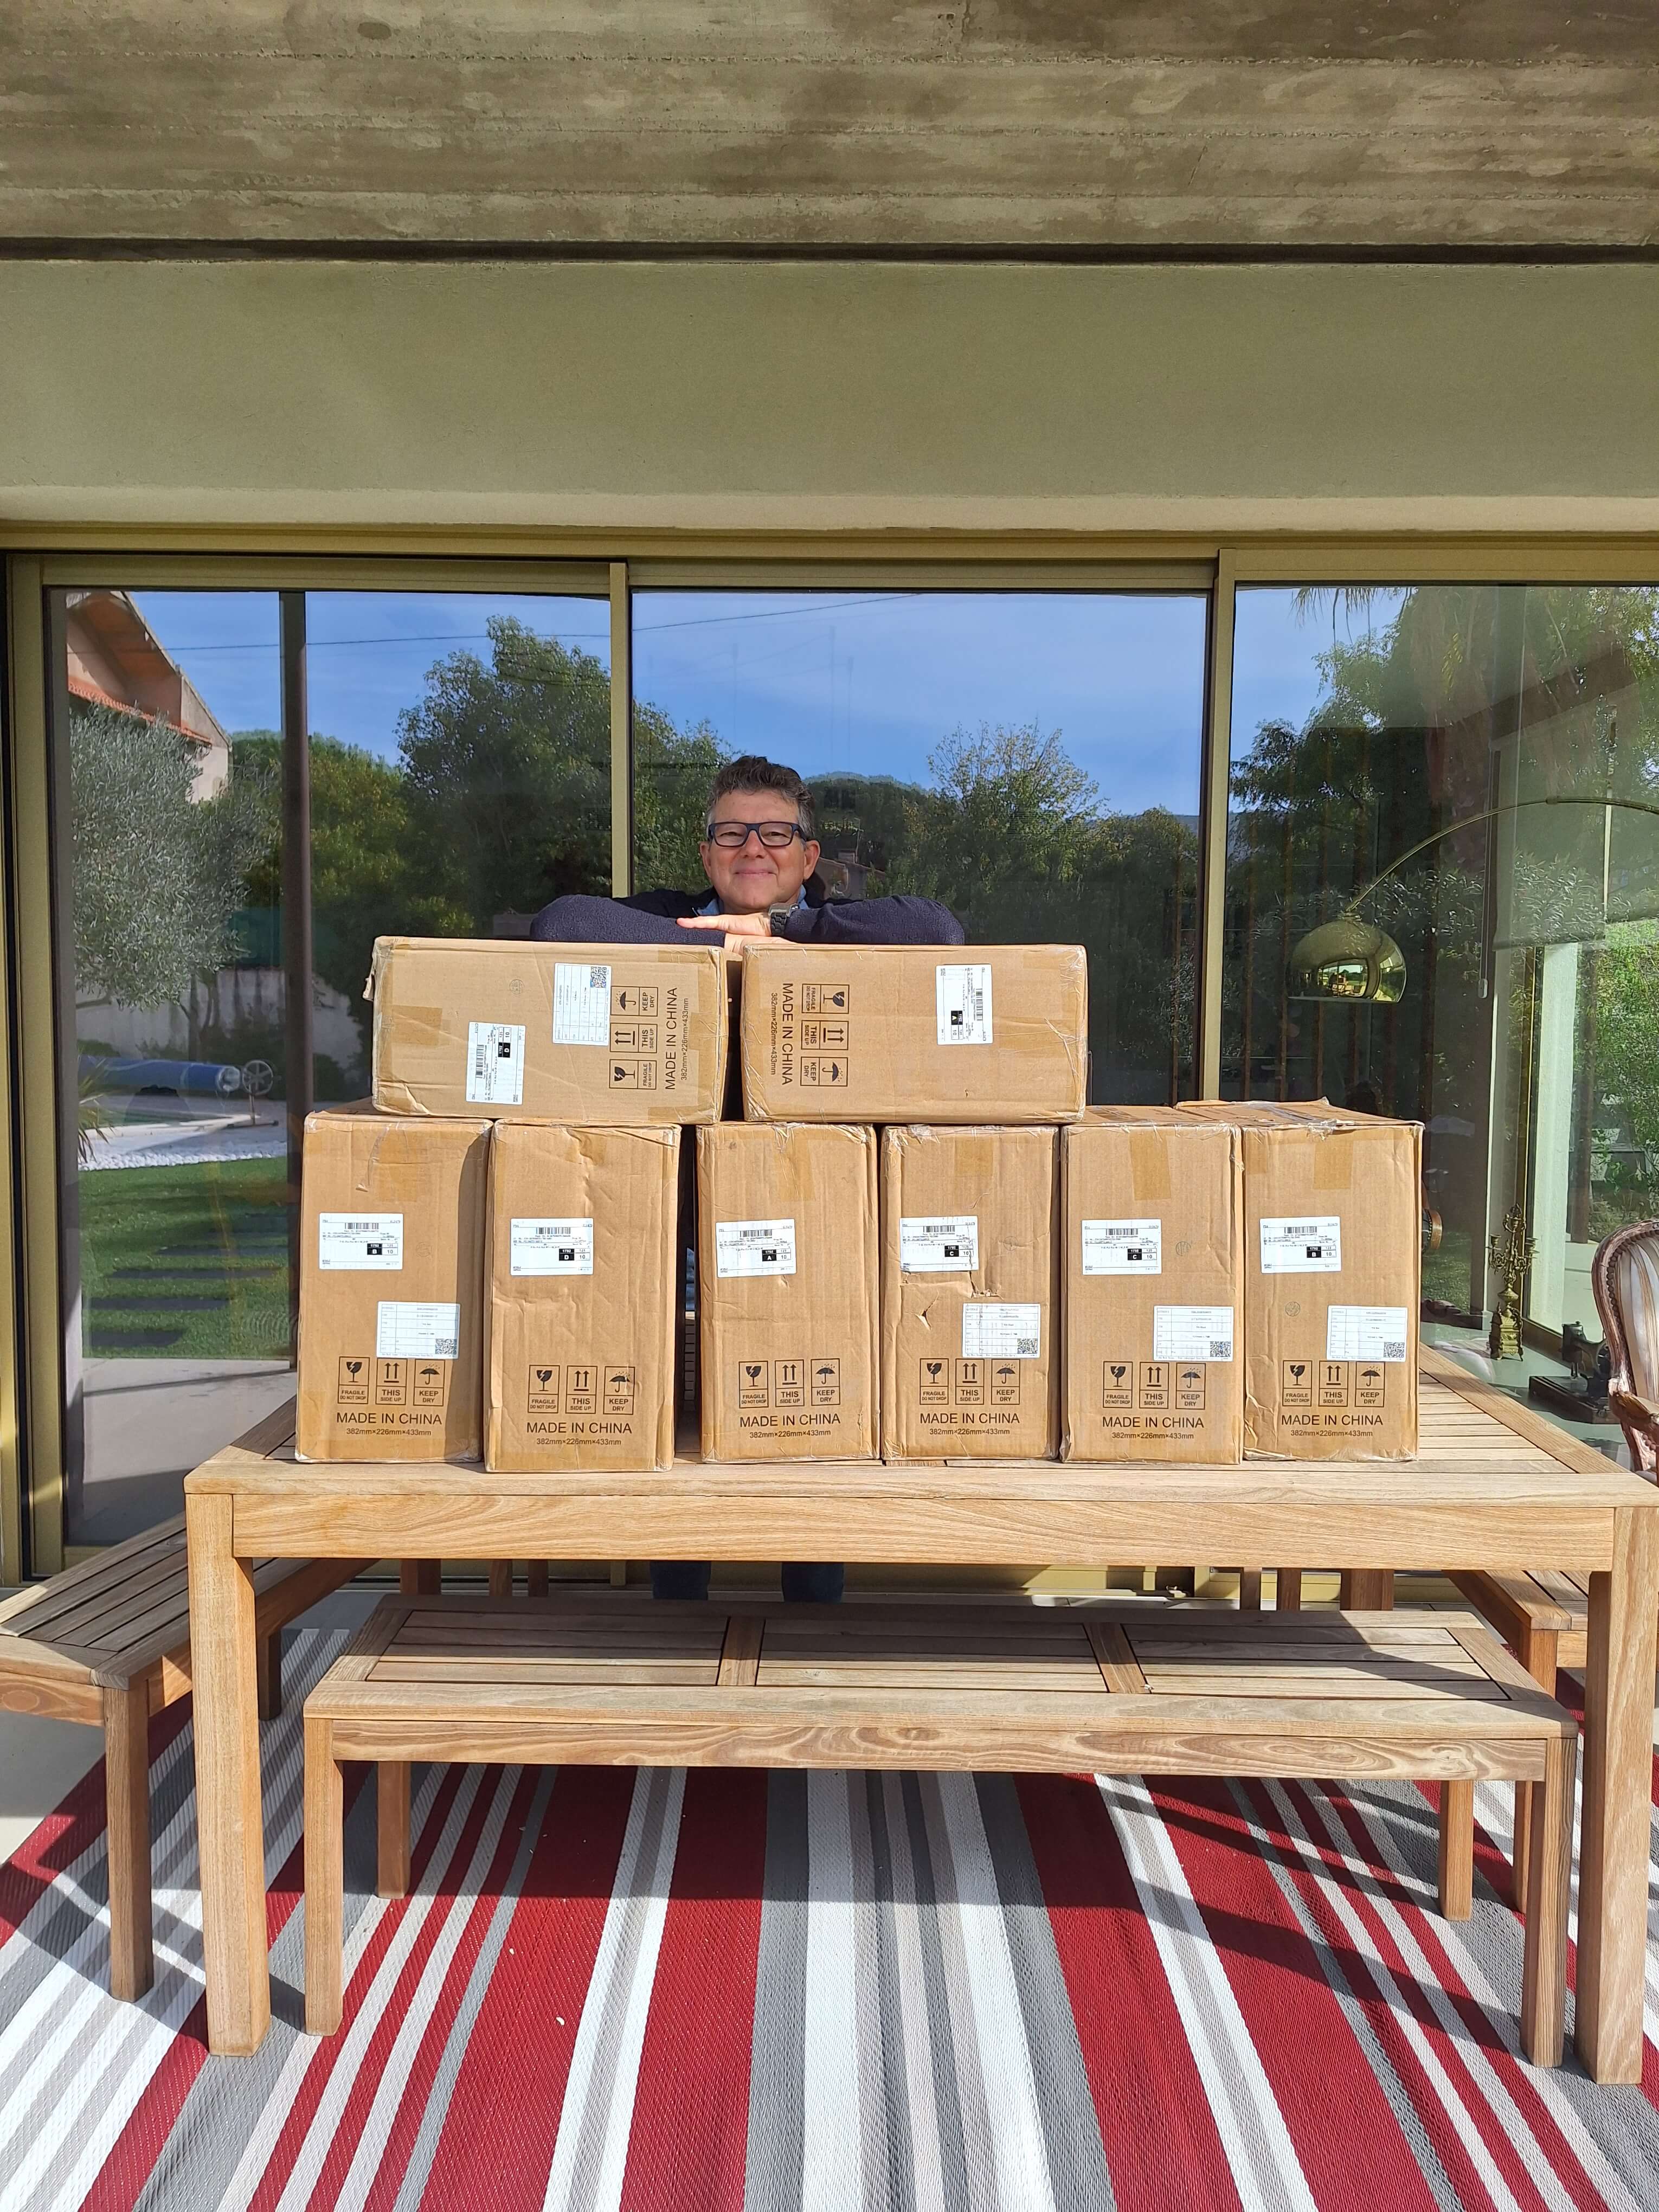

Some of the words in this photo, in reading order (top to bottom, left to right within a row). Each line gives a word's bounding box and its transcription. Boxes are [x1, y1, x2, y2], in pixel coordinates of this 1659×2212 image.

[782, 983, 793, 1021] MADE
[666, 988, 677, 1029] CHINA
[782, 1027, 793, 1038] IN
[666, 1035, 676, 1046] IN
[782, 1044, 793, 1085] CHINA
[665, 1052, 676, 1089] MADE
[337, 1413, 377, 1423] MADE
[382, 1413, 394, 1423] IN
[400, 1414, 442, 1424] CHINA
[740, 1416, 778, 1427] MADE
[783, 1415, 795, 1425] IN
[800, 1413, 840, 1425] CHINA
[920, 1413, 957, 1423] MADE
[962, 1413, 974, 1423] IN
[979, 1413, 1020, 1423] CHINA
[1103, 1417, 1140, 1427] MADE
[1146, 1417, 1157, 1427] IN
[1162, 1417, 1204, 1428] CHINA
[1282, 1415, 1320, 1425] MADE
[1325, 1415, 1336, 1425] IN
[1341, 1415, 1383, 1426] CHINA
[527, 1422, 567, 1433] MADE
[571, 1423, 584, 1433] IN
[589, 1423, 632, 1433] CHINA
